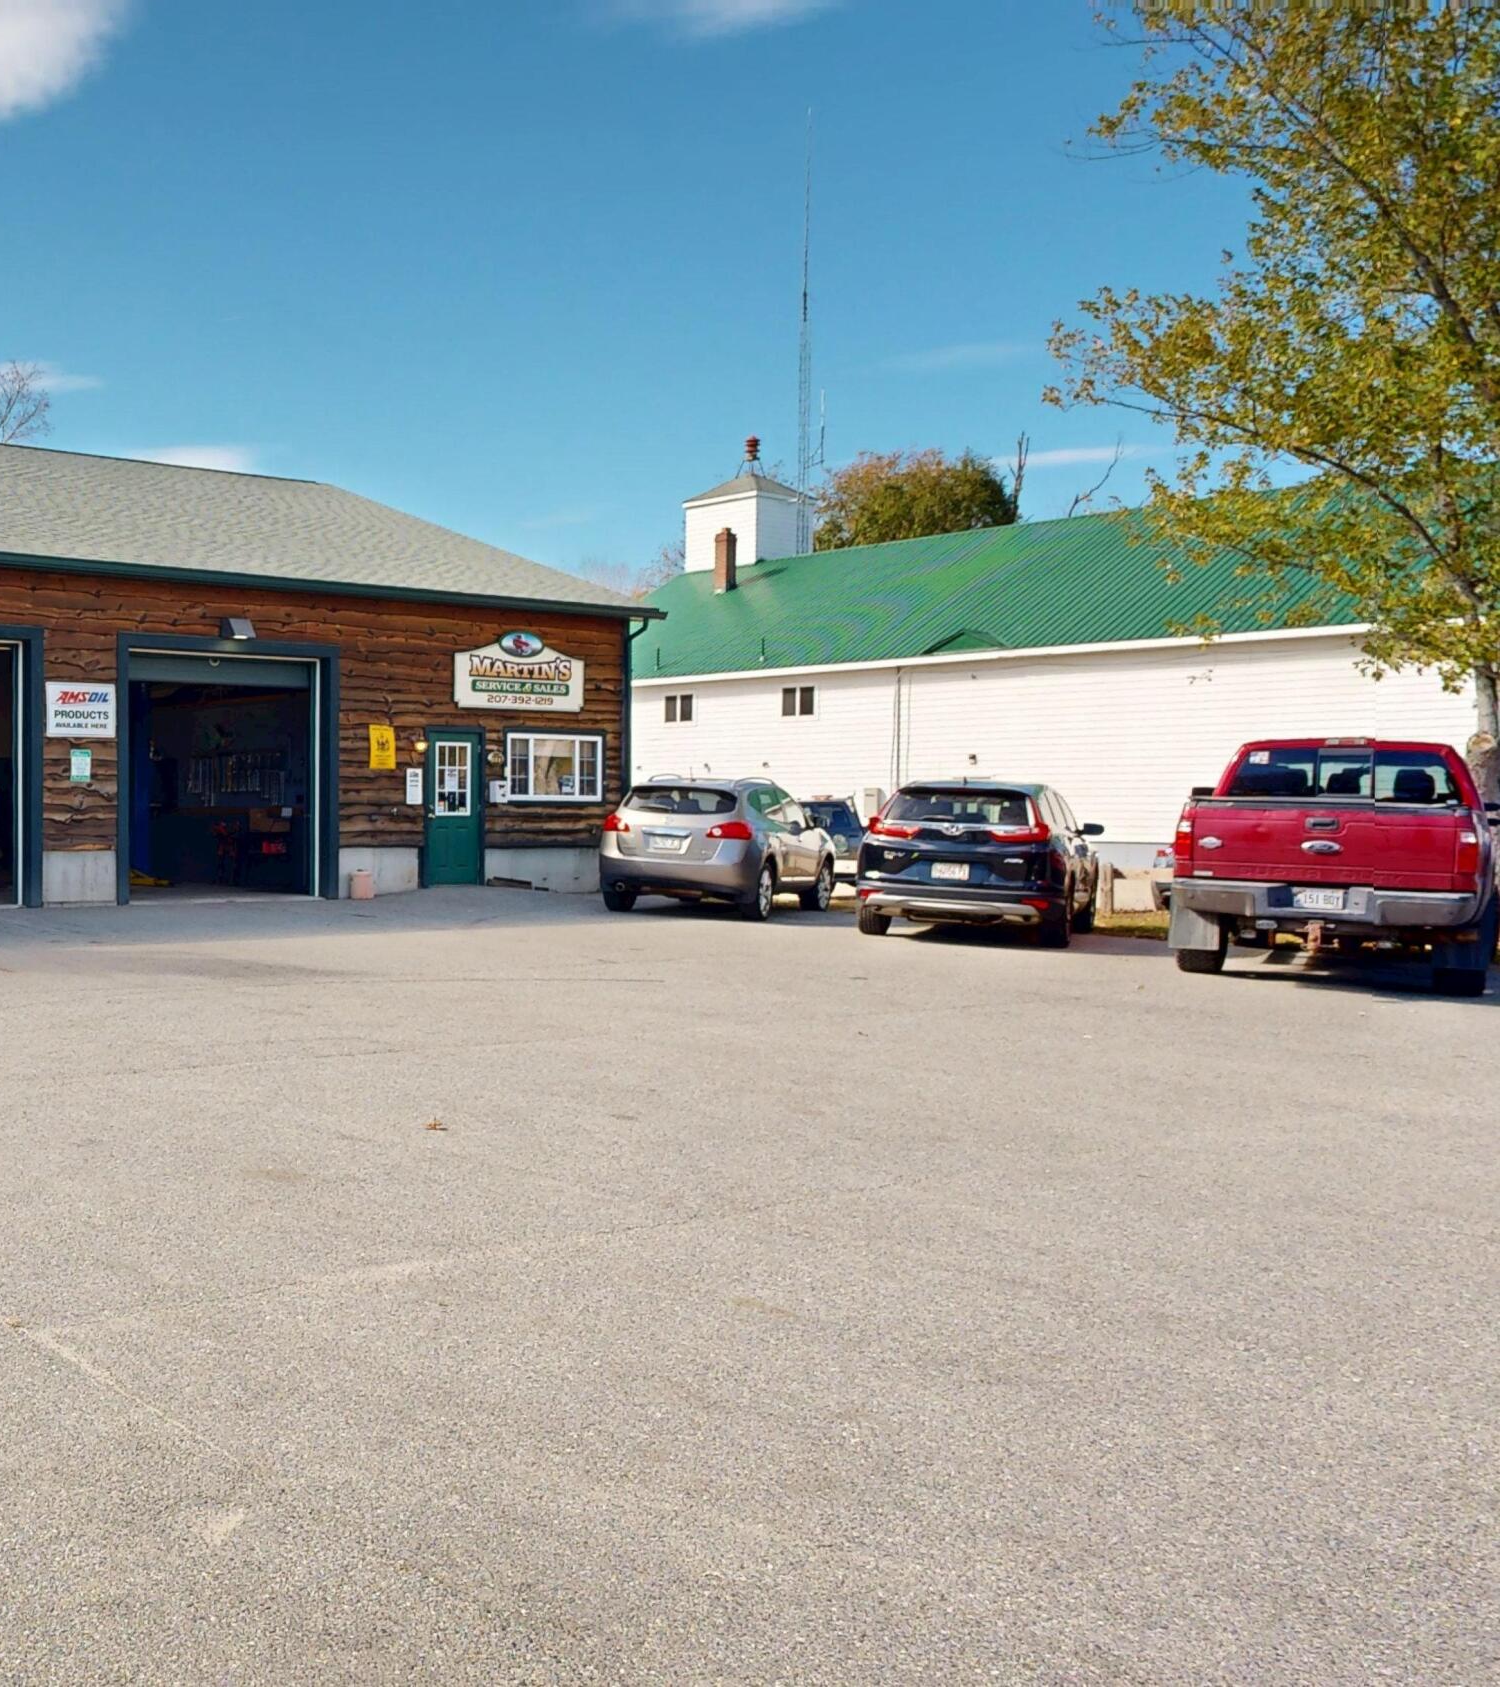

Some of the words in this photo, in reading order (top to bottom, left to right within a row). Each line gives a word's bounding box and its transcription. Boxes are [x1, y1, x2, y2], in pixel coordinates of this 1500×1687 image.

[469, 654, 572, 682] MARTIN'S
[475, 681, 521, 691] SERVICE
[533, 684, 567, 694] SALES
[56, 690, 109, 705] AMSOIL
[54, 709, 109, 720] PRODUCTS
